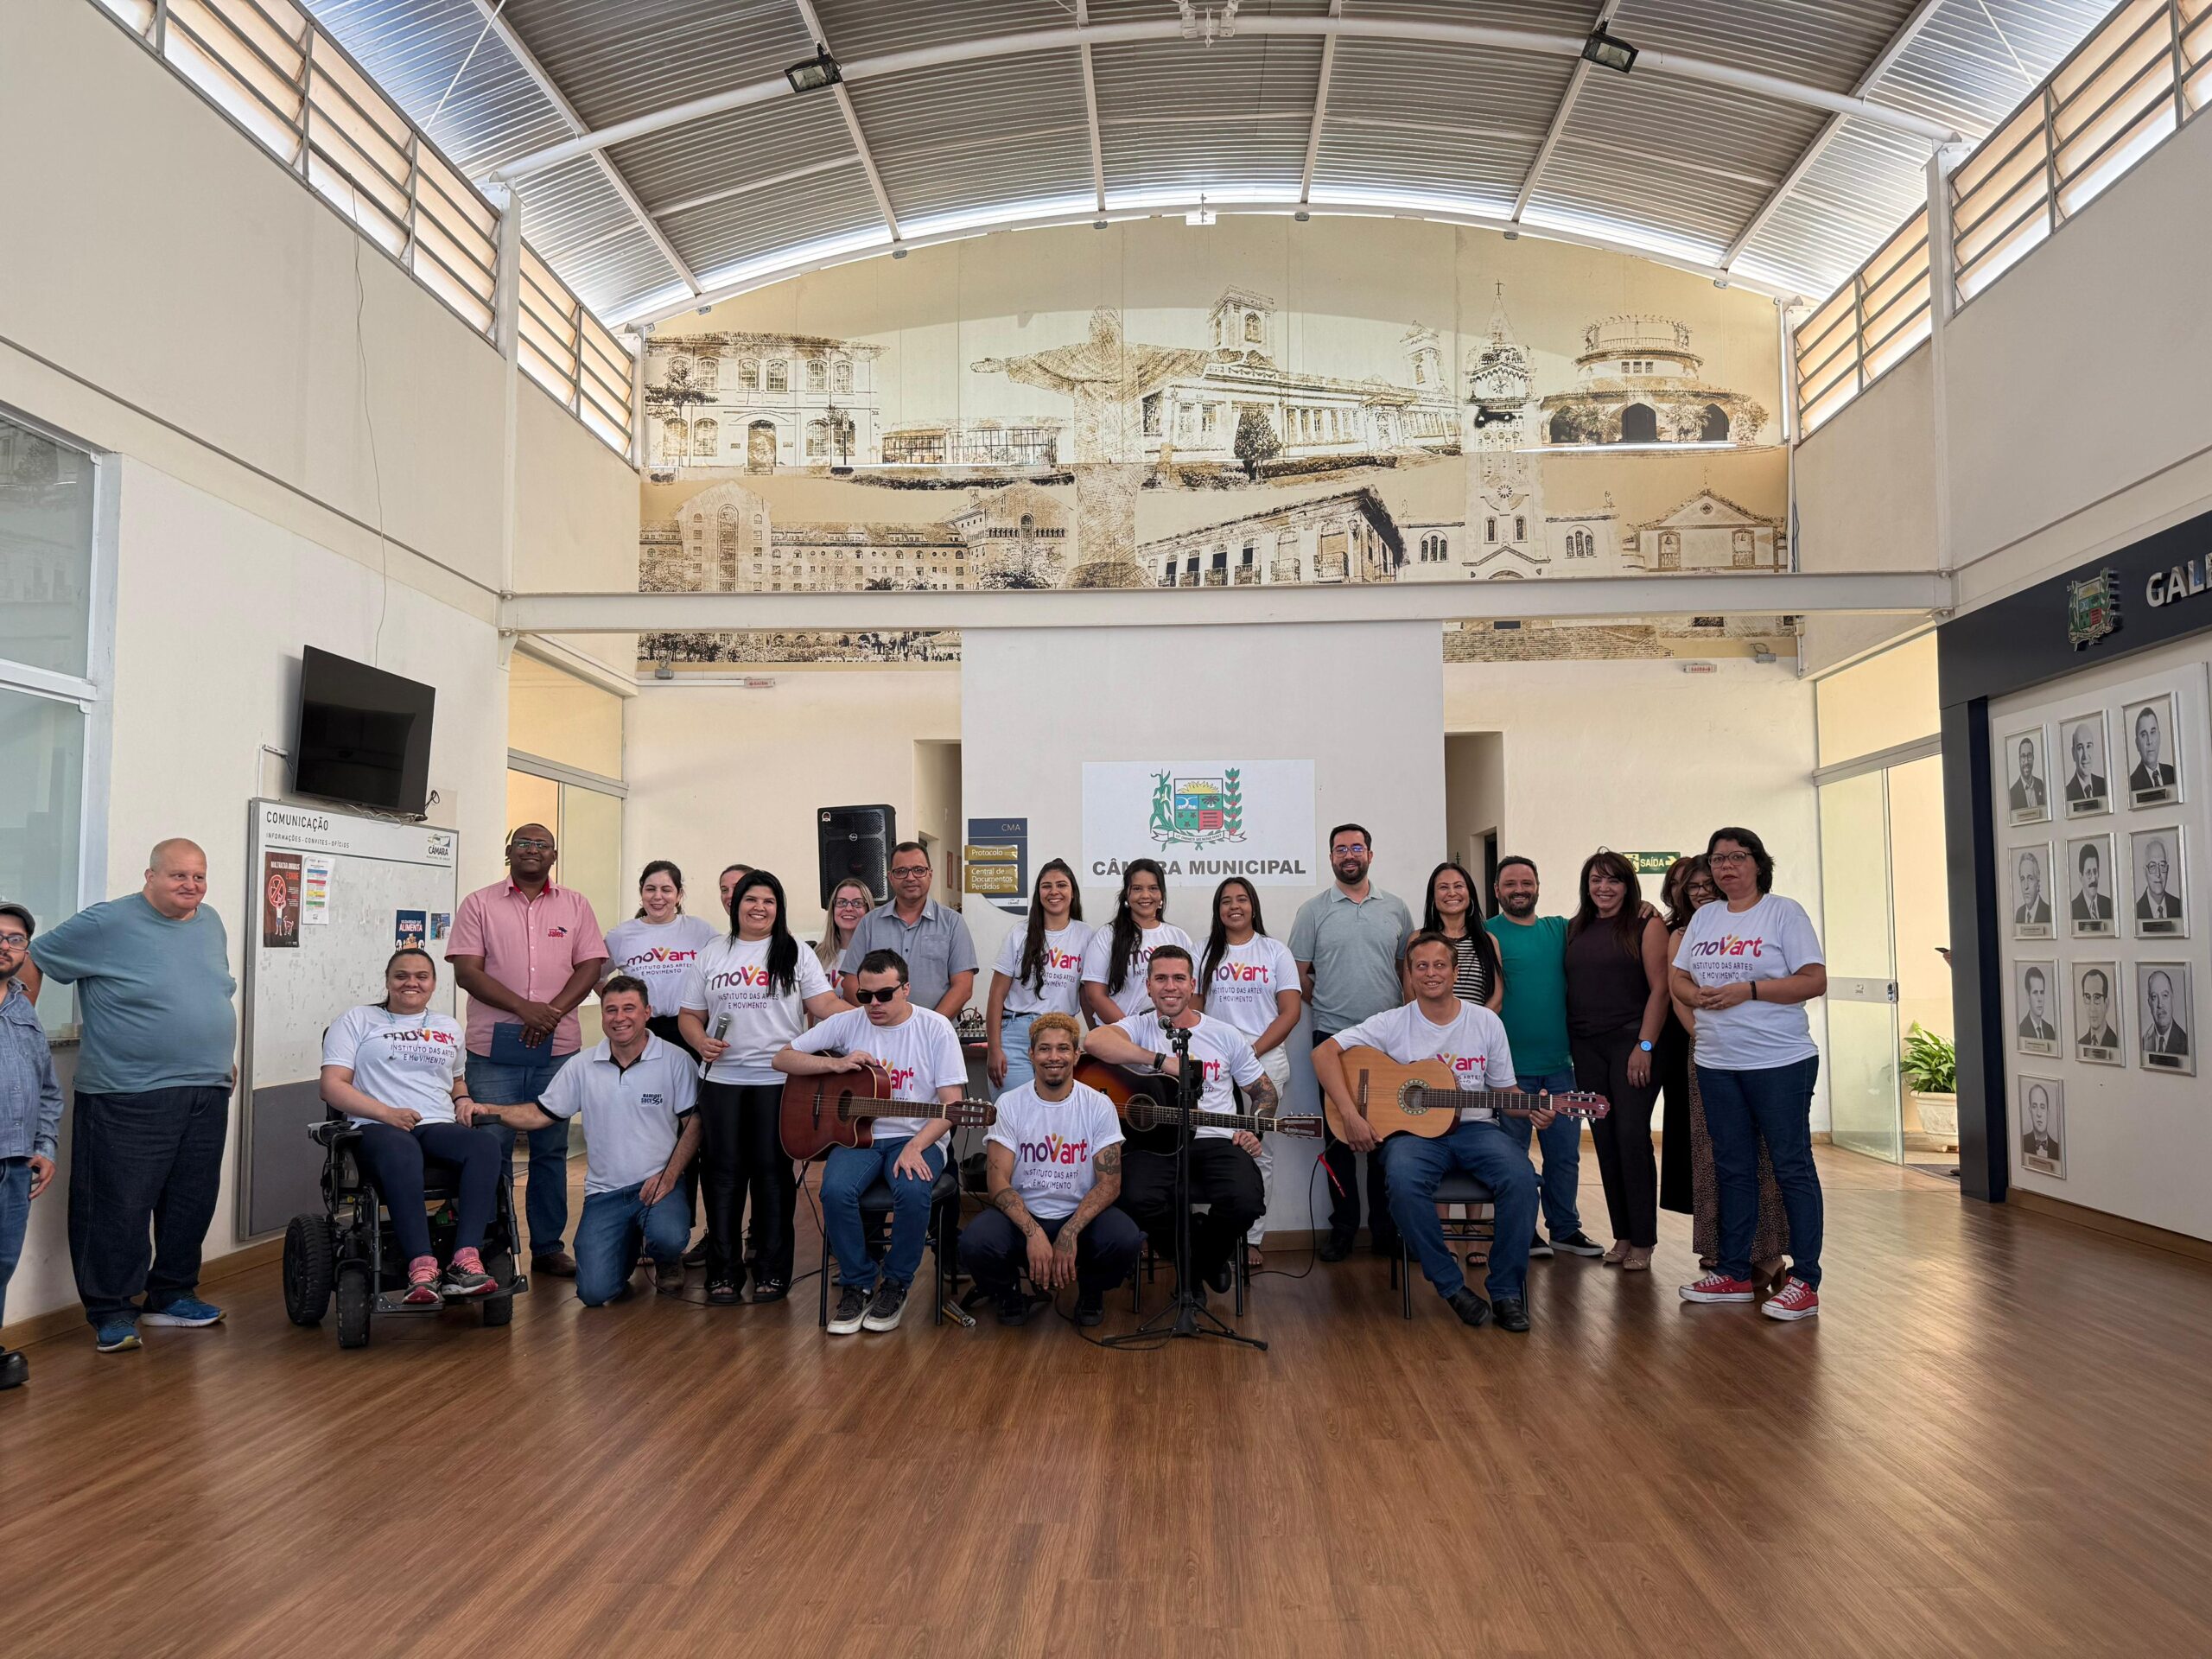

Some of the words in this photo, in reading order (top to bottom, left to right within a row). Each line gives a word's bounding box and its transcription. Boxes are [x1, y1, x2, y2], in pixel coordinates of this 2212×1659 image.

[266, 810, 328, 833] COMUNICAÇÃO
[429, 845, 449, 856] CÂMARA
[1640, 856, 1664, 868] SAÍDA
[1092, 858, 1182, 876] CÂRA
[1189, 860, 1306, 875] MUNICIPAL
[399, 923, 423, 931] ALIMENTA
[548, 930, 564, 938] Jales
[1733, 963, 1753, 971] ARTES
[1702, 971, 1706, 980] E
[718, 992, 747, 1001] INSTITUTO
[442, 1049, 454, 1058] ARTES
[1024, 1168, 1052, 1178] INSTITUTO
[1054, 1171, 1065, 1179] DAS
[1037, 1180, 1071, 1190] MOVIMENTO
